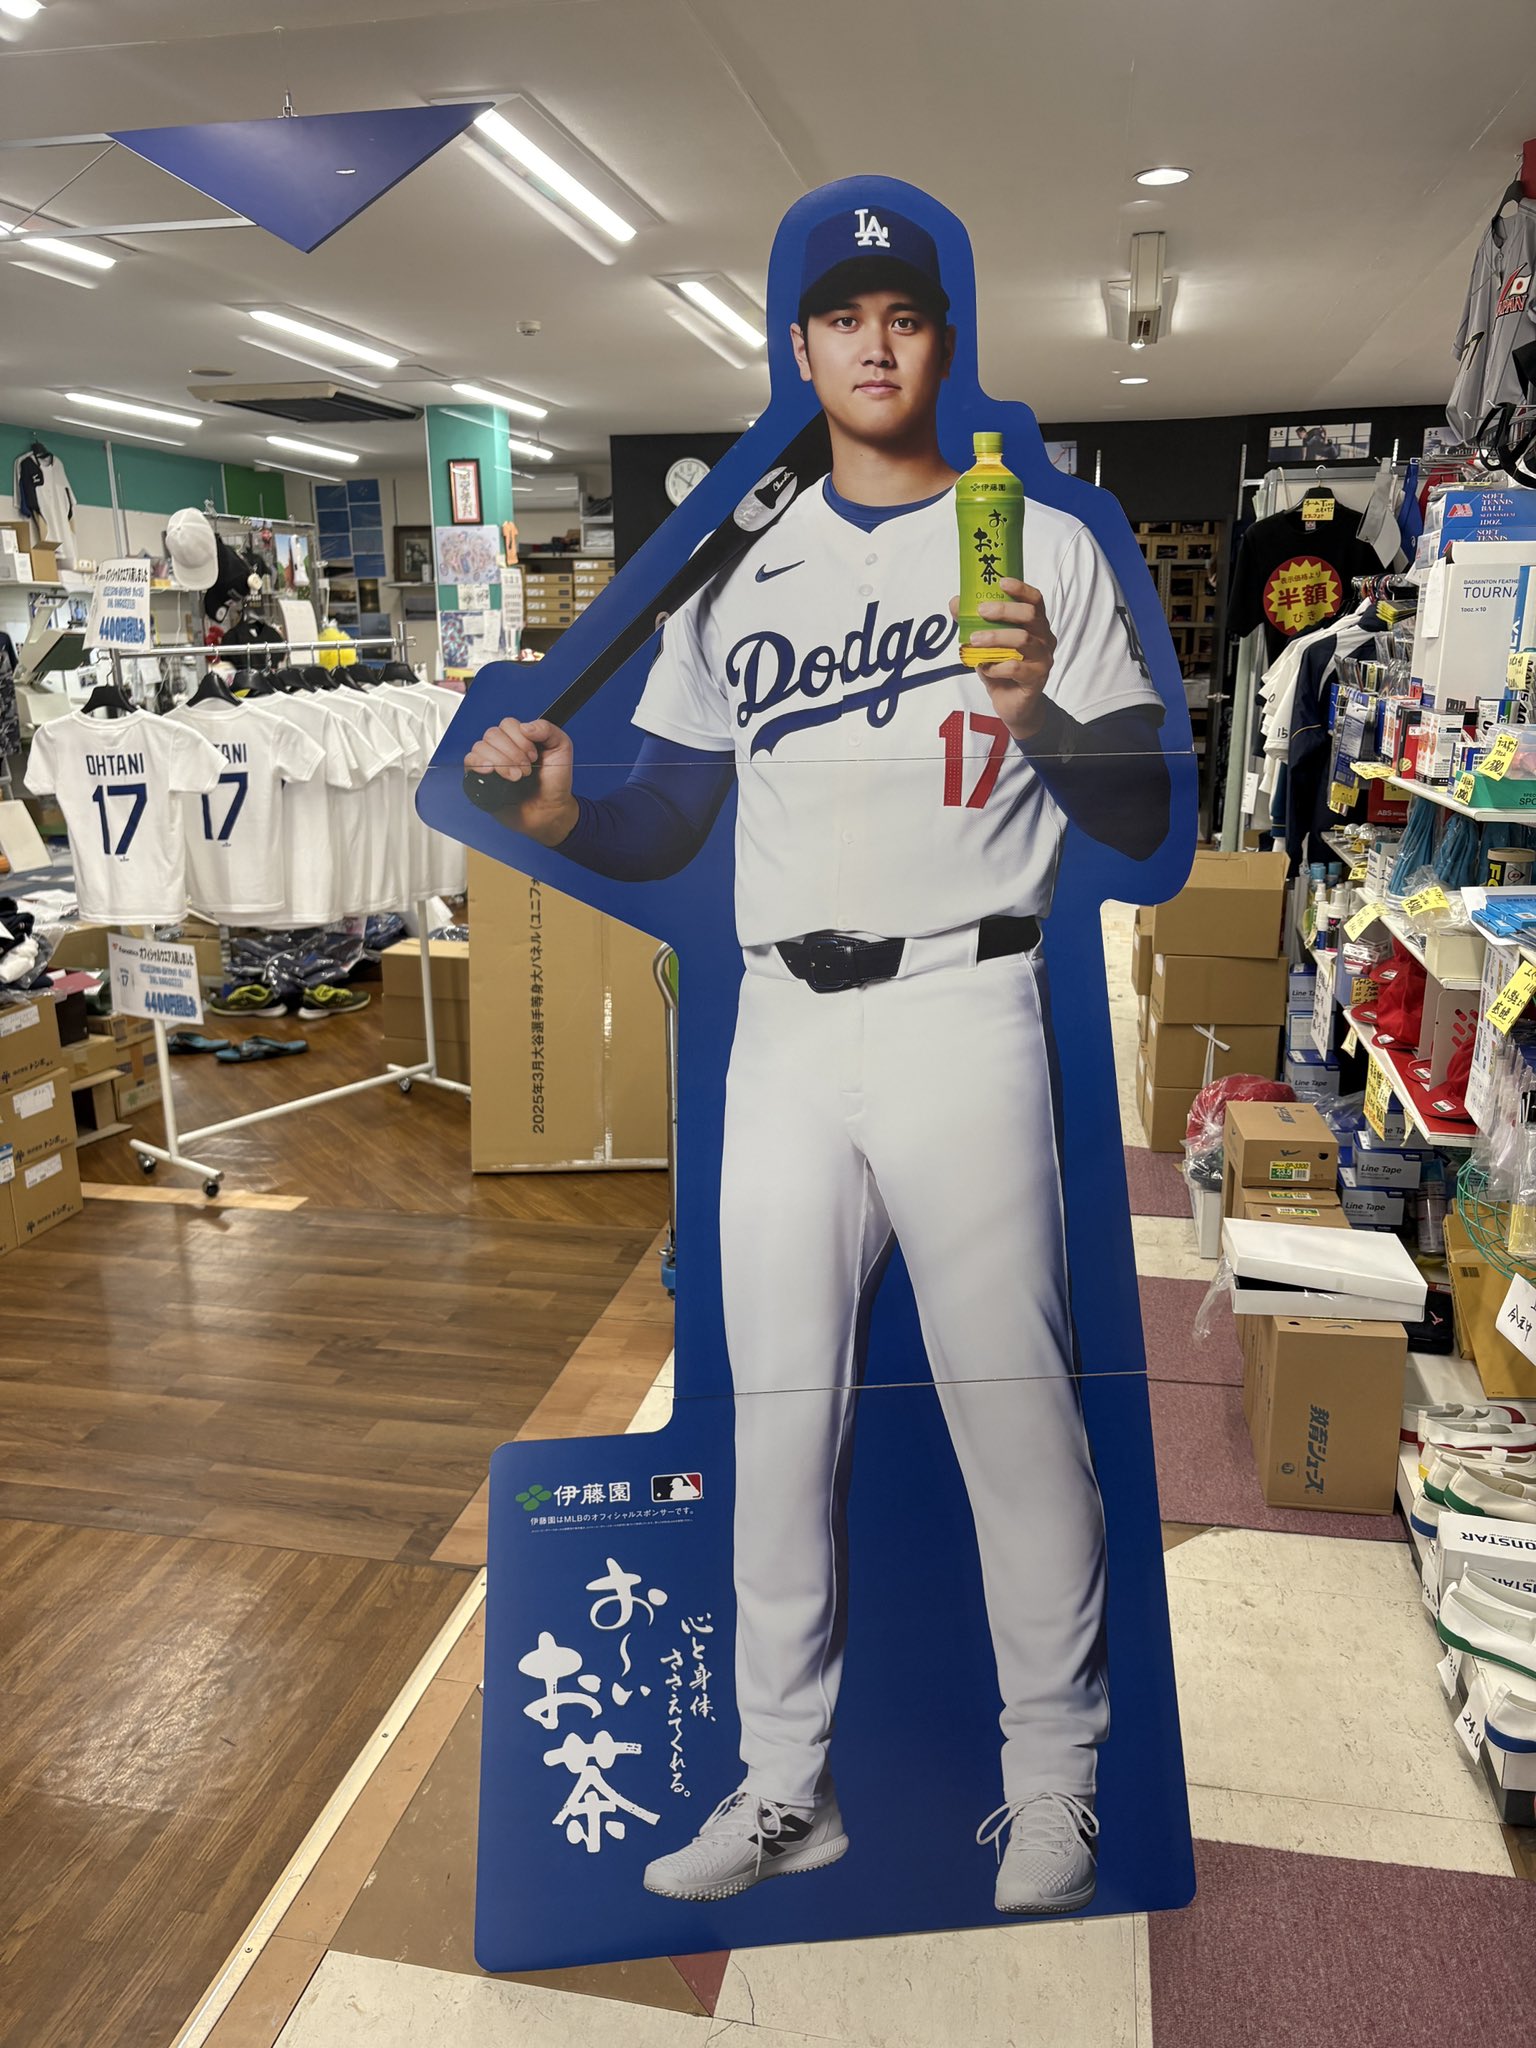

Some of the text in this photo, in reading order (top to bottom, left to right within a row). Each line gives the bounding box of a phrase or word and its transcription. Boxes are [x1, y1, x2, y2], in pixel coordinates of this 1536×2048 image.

[854, 208, 890, 248] LA
[981, 483, 1007, 492] 伊藤園
[1481, 493, 1505, 501] SOFT
[973, 527, 1004, 585] お茶
[1277, 582, 1329, 611] 半額
[1277, 727, 1289, 739] 15
[86, 752, 145, 776] OHTANI
[938, 709, 1012, 809] 17
[92, 783, 148, 855] 17
[201, 772, 248, 841] 17
[1311, 1079, 1328, 1087] Tape
[1396, 1126, 1416, 1135] Tae
[1361, 1164, 1403, 1174] Line Tape
[1345, 1201, 1386, 1211] Line Tape
[1305, 1404, 1329, 1494] 教育シューズ
[553, 1481, 631, 1507] 伊藤園
[530, 1506, 695, 1526] 伊藤園はMLBのオフィシャルスポンサーです。
[681, 1612, 717, 1724] 心と身体、
[660, 1648, 692, 1798] ささえてくれる。
[518, 1632, 661, 1853] お茶
